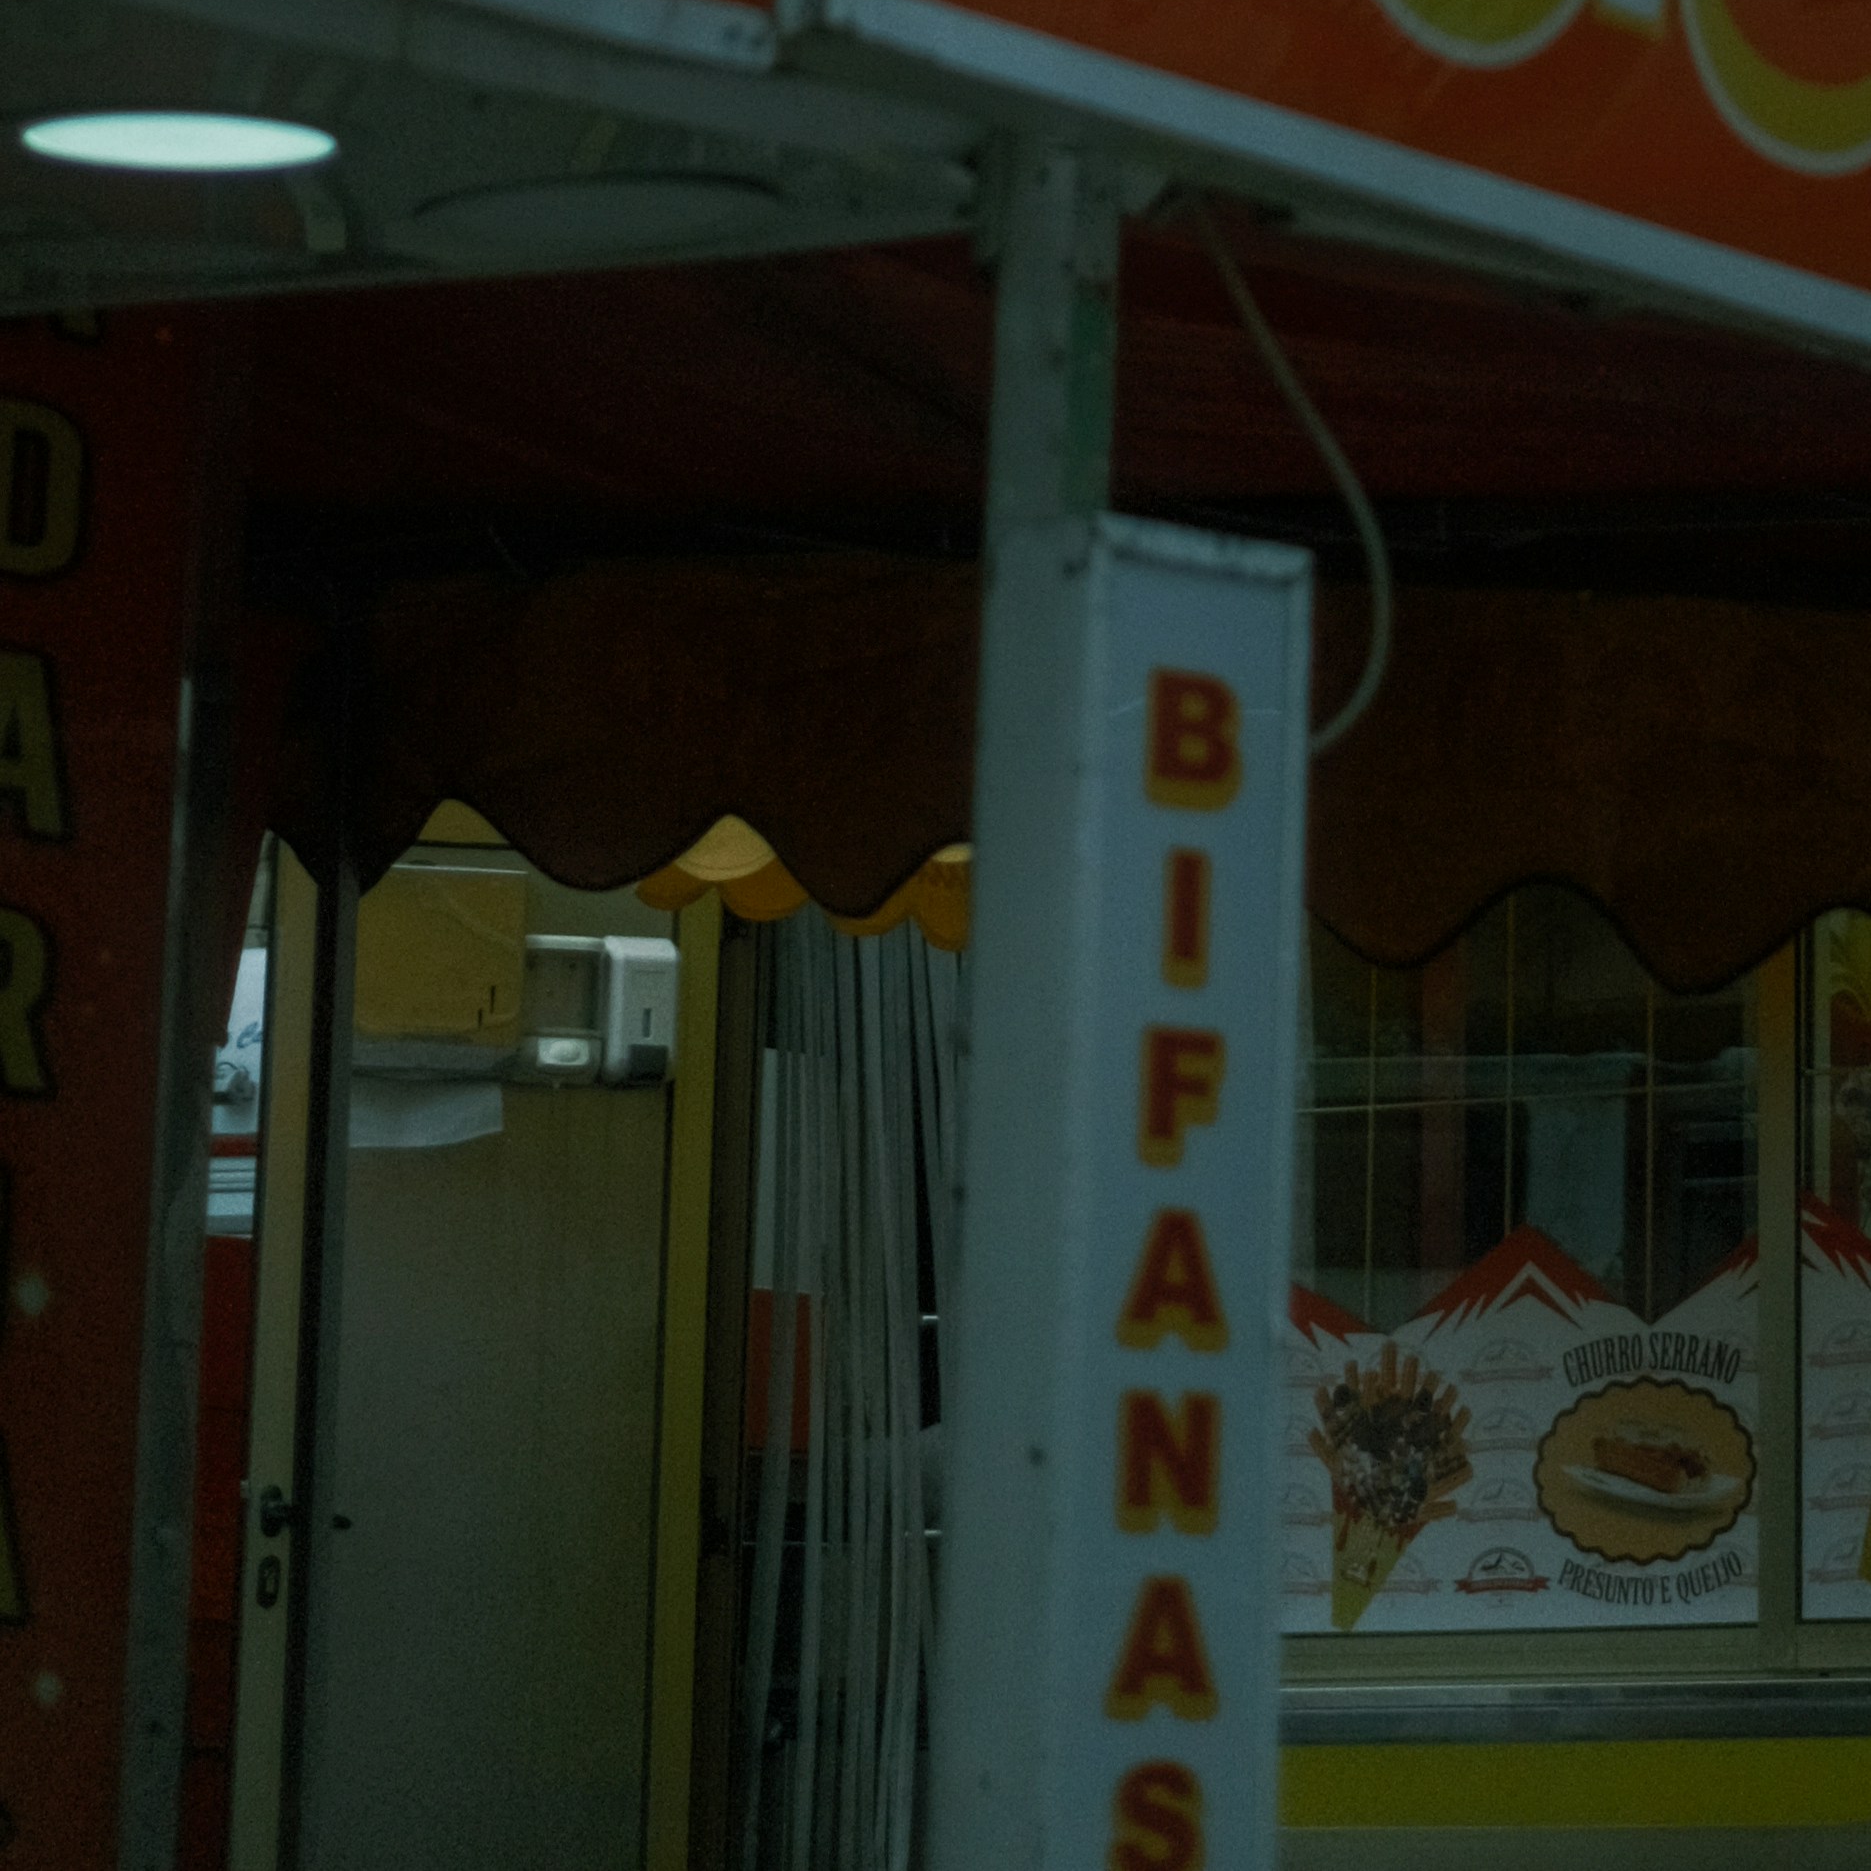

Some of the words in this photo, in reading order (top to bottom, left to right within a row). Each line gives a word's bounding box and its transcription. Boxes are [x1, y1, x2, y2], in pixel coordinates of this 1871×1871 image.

[1103, 666, 1243, 1871] BIFANAS
[1563, 1334, 1643, 1387] CHURRO
[1649, 1332, 1741, 1384] SERRANO
[1558, 1559, 1655, 1606] PRESUNTO
[1660, 1575, 1671, 1605] E
[1676, 1550, 1743, 1604] QUEIJO
